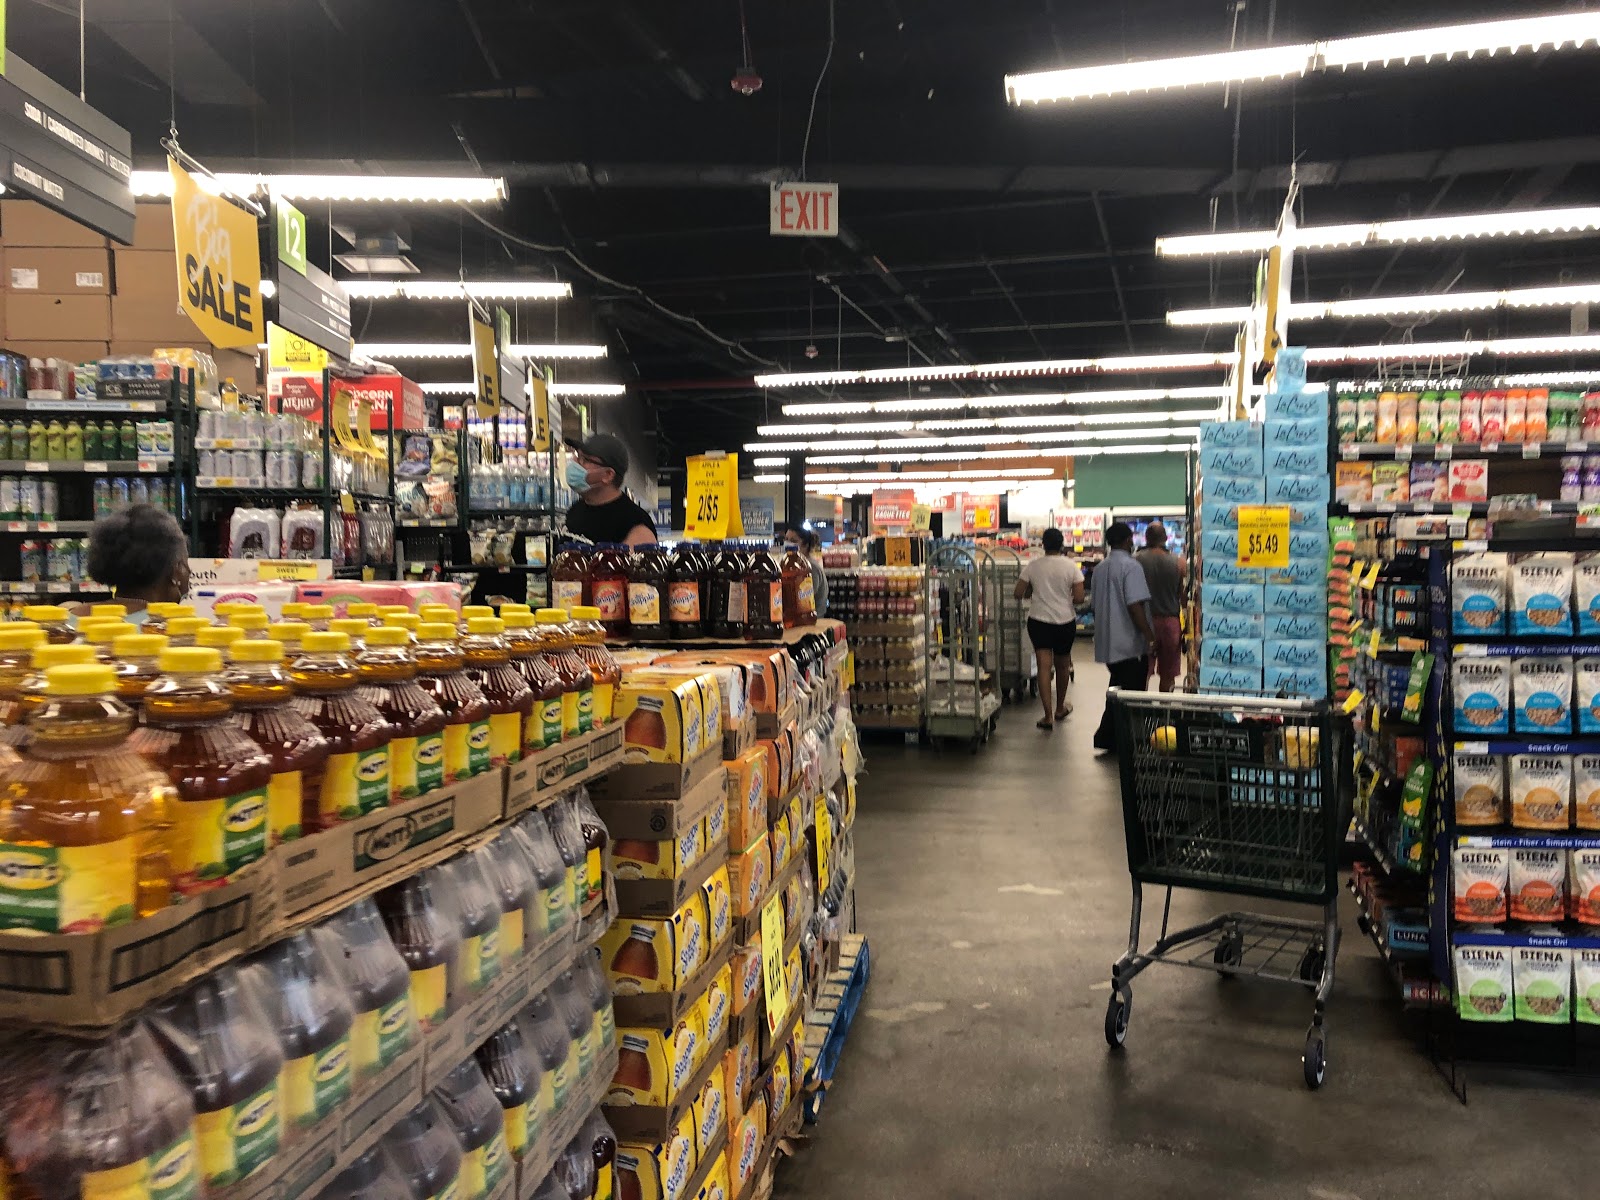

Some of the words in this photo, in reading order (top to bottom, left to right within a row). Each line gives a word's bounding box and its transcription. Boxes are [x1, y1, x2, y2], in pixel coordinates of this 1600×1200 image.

[780, 191, 832, 230] EXIT
[283, 208, 301, 262] 12
[186, 193, 233, 292] Big
[185, 253, 253, 332] SALE
[697, 494, 719, 524] 2/$5
[648, 508, 671, 525] AIR
[1249, 532, 1278, 556] $5.49
[189, 569, 217, 580] outh
[1457, 567, 1497, 577] BIENA
[1520, 566, 1563, 577] BIENA
[1459, 664, 1503, 674] BIENA
[1520, 663, 1564, 674] BIENA
[1457, 757, 1497, 768] BIENA
[1519, 758, 1564, 770] BIENA
[1461, 853, 1502, 864] BIENA
[1516, 851, 1559, 863] BIENA
[1396, 932, 1426, 943] LUNA
[1462, 949, 1505, 960] BIENA
[1520, 950, 1563, 962] BIENA
